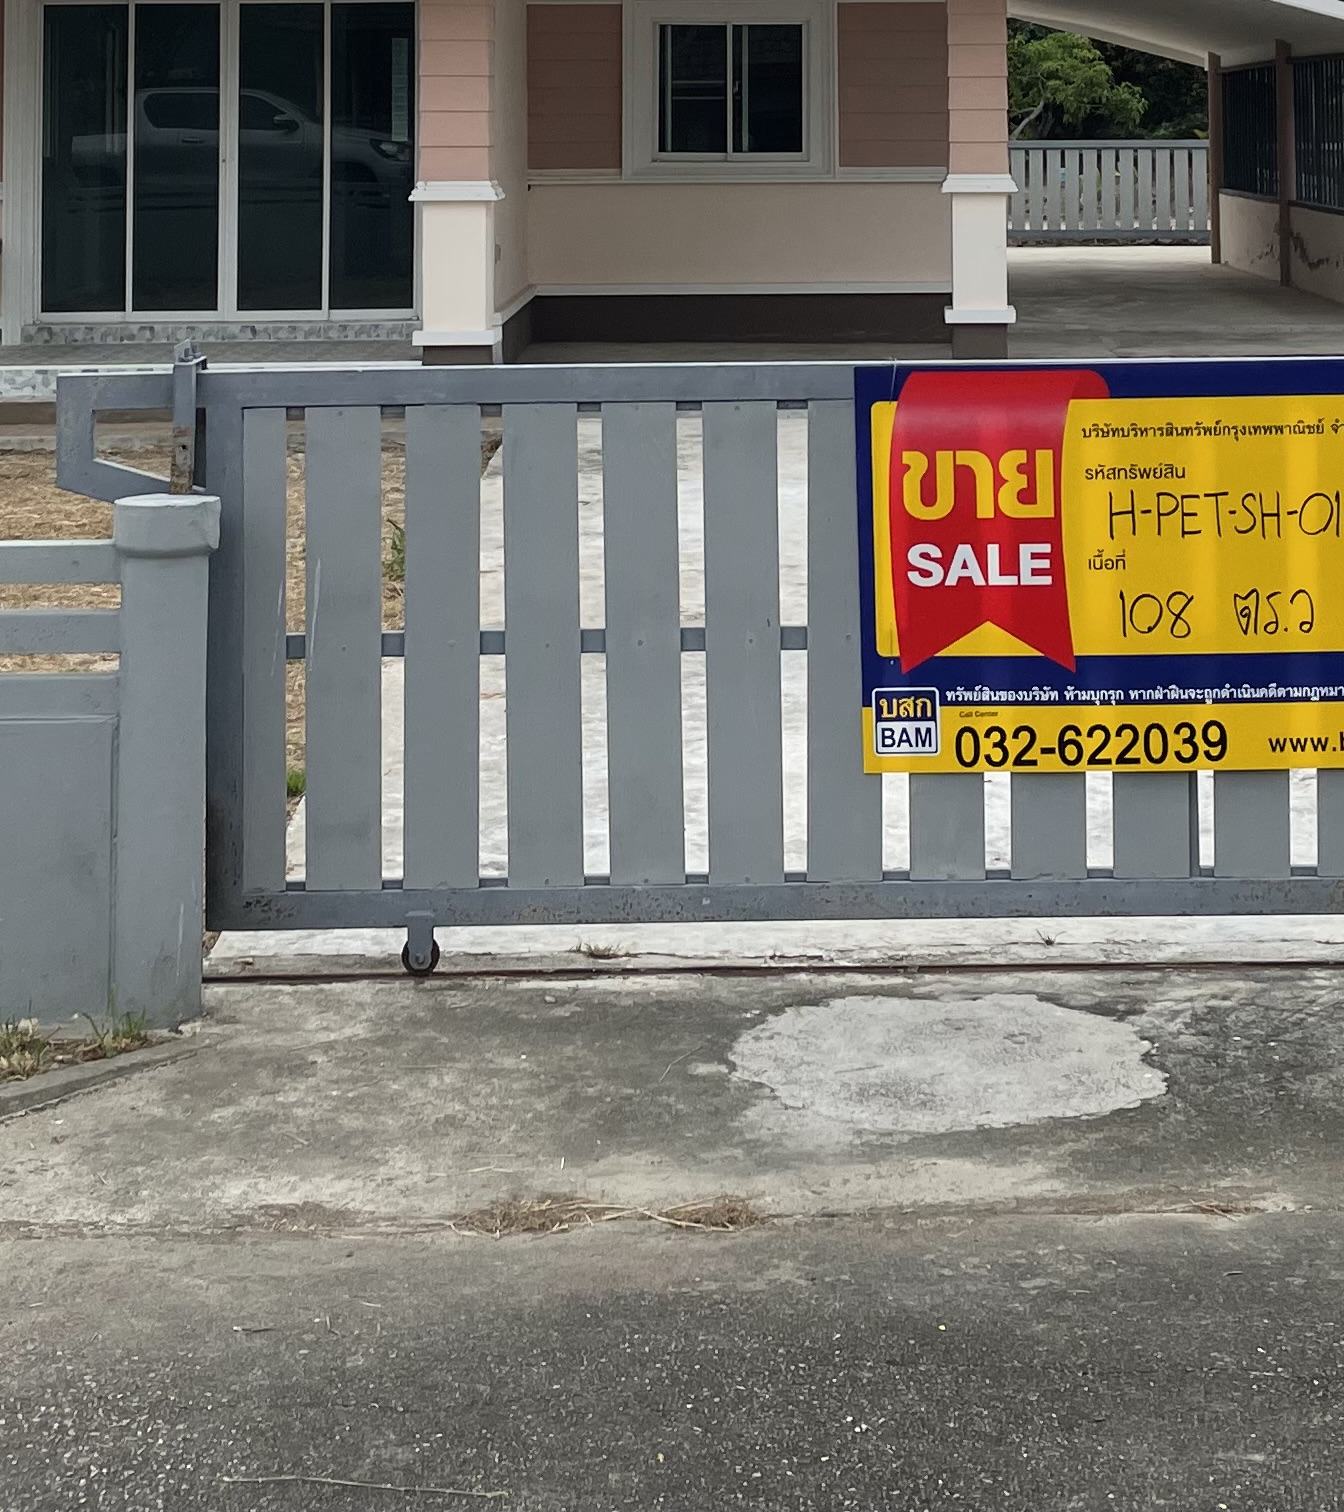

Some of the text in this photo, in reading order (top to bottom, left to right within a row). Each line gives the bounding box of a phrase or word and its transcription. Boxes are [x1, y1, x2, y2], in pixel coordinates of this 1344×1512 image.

[1081, 418, 1325, 441] บริษัทบริหารสินทรัพย์กรุงเทพพาณิชย์
[1084, 462, 1186, 480] รหัสทรัพย์สิน
[901, 449, 1055, 520] ขาย
[907, 543, 1053, 587] SALE
[1088, 549, 1127, 571] เนื้อที่
[1119, 589, 1194, 638] 108
[945, 685, 1059, 702] ทรัพย์สินของบริษัท
[1064, 686, 1124, 705] ห้ามบุกรุก
[879, 696, 932, 719] บสก
[881, 727, 933, 748] BAM
[955, 719, 1228, 768] 032-622039
